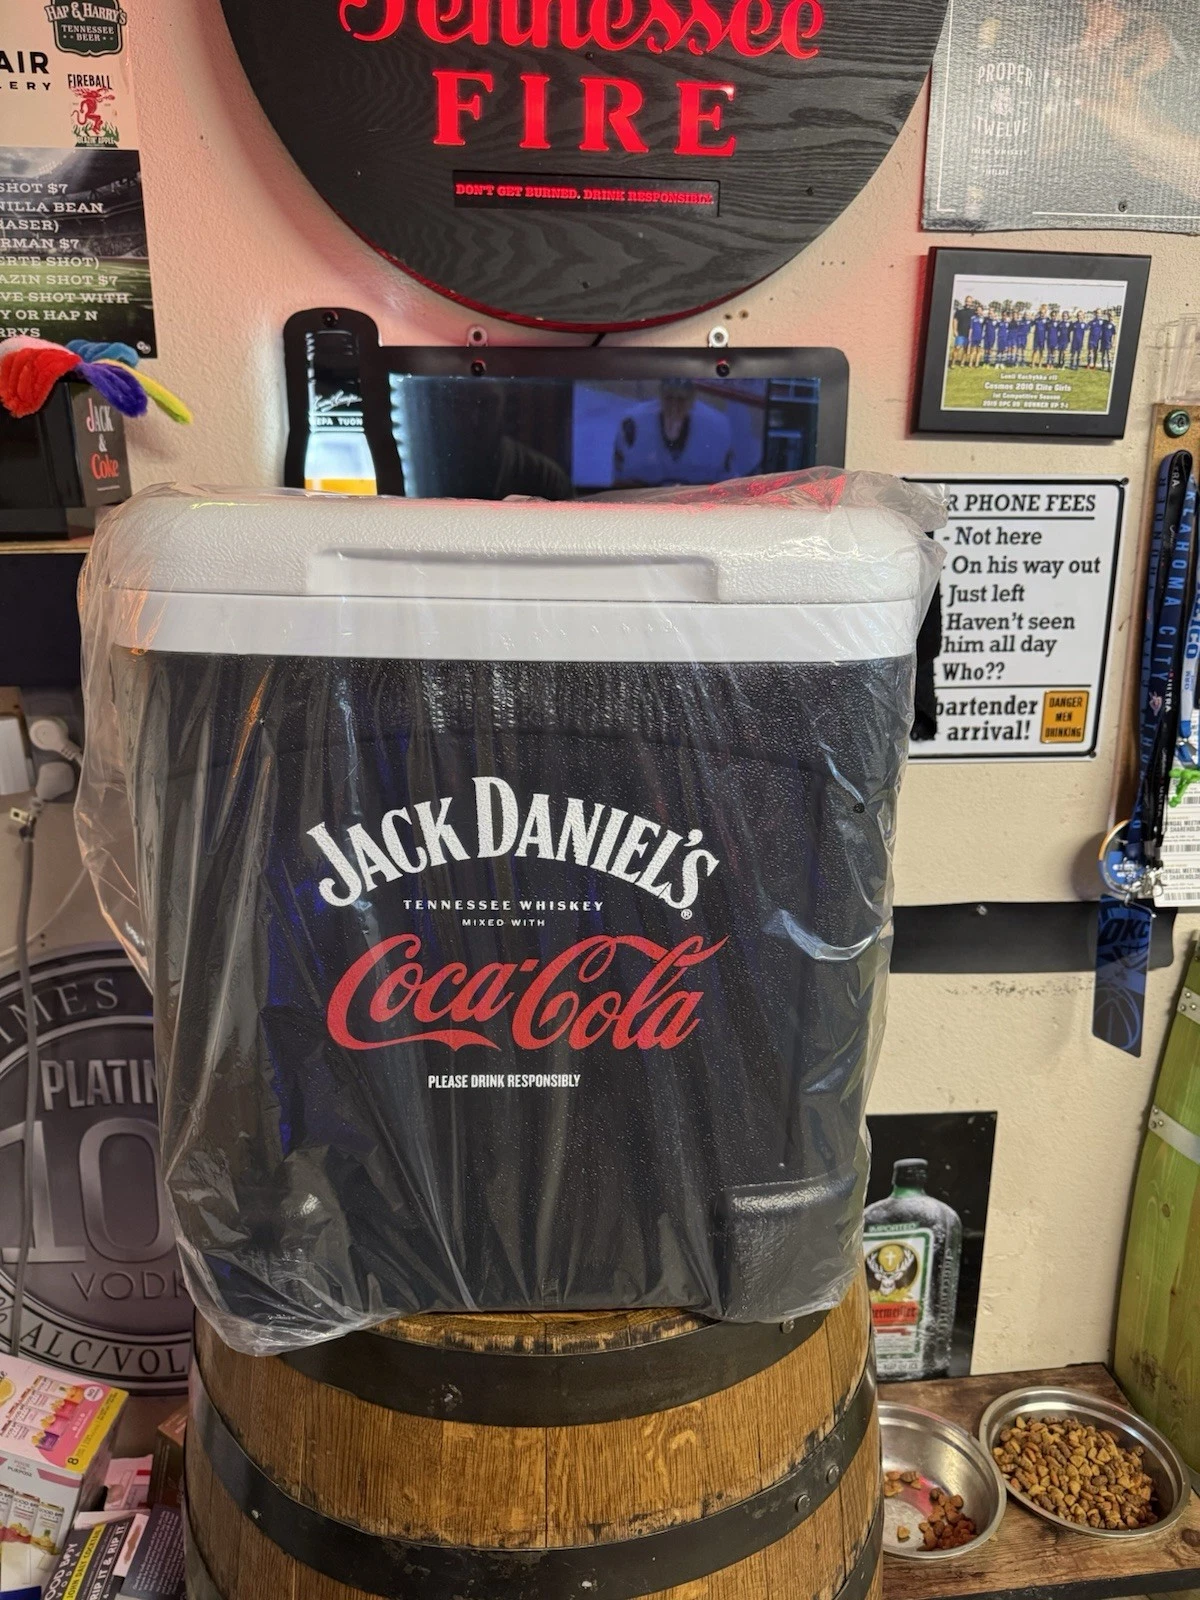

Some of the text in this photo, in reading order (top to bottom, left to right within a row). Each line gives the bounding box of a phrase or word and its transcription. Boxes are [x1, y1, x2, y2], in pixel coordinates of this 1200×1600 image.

[45, 1, 127, 25] HAP & HARRY'S
[61, 24, 115, 35] TENNESSEE
[76, 33, 101, 42] BEER
[67, 74, 113, 90] FIREBALL
[978, 62, 1033, 87] PROPER
[0, 81, 51, 91] ERY
[432, 70, 737, 157] FIRE
[976, 117, 1029, 138] TWELVE
[47, 183, 69, 194] $7
[456, 184, 495, 197] DON'T
[496, 185, 523, 198] GET
[583, 188, 626, 202] DRINK
[54, 203, 104, 214] BEAN
[60, 238, 80, 250] $7
[46, 257, 100, 271] SHOT)
[46, 275, 93, 286] SHOT
[98, 275, 118, 286] $7
[28, 292, 75, 303] SHOT
[79, 293, 130, 304] WITH
[15, 310, 43, 320] OR
[43, 310, 80, 321] HAP
[85, 311, 98, 321] N
[984, 382, 1014, 390] Cosmos
[1015, 383, 1034, 391] 2010
[1036, 384, 1053, 392] Elite
[86, 398, 115, 433] JACK
[98, 434, 108, 452] &
[90, 455, 120, 480] Coke
[964, 494, 1041, 512] PHONE
[1045, 494, 1096, 512] FEES
[955, 527, 991, 545] Not
[997, 527, 1042, 545] here
[952, 556, 1101, 579] On his way out
[948, 585, 1025, 607] Just left
[947, 613, 1075, 631] Haven't seen
[943, 635, 1058, 658] him all day
[1151, 626, 1177, 681] CITY
[943, 662, 1005, 681] Who??
[936, 695, 1038, 716] bartender
[1047, 697, 1083, 708] DANGER
[1055, 712, 1072, 722] MEN
[947, 720, 1031, 741] arrival!
[1045, 727, 1081, 738] DRINKING
[307, 776, 720, 910] JACK DANIEL'S
[403, 899, 603, 912] TENNESSEE WHISKEY
[462, 918, 545, 927] MIXED WITH
[327, 933, 729, 1052] Coca-Cola
[428, 1074, 581, 1089] PLEASE DRINK RESPONSIBLY
[870, 1223, 917, 1233] IMPORTED
[20, 1322, 186, 1376] ALC/VOL
[67, 1457, 79, 1465] 8
[97, 1569, 107, 1579] IT
[102, 1557, 112, 1565] &
[108, 1537, 120, 1554] RIP
[67, 1580, 79, 1598] JOHN
[74, 1564, 85, 1578] DALY
